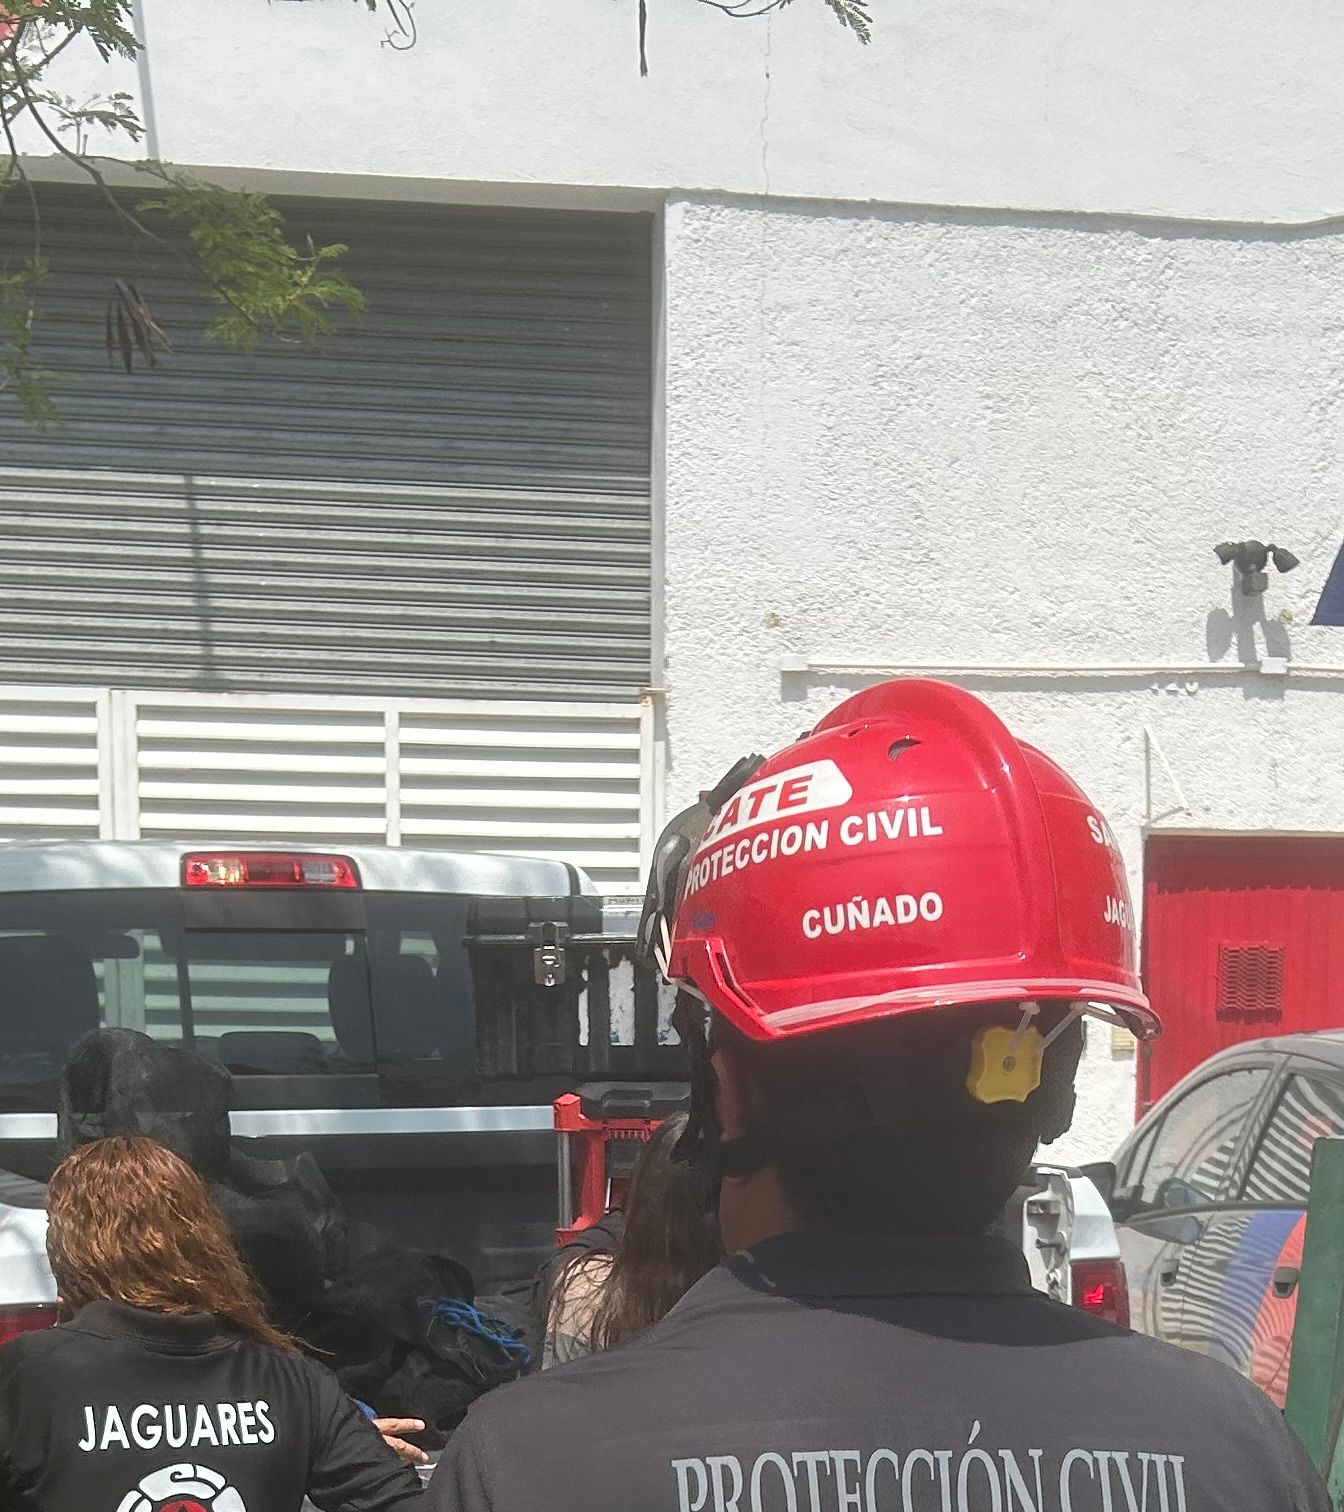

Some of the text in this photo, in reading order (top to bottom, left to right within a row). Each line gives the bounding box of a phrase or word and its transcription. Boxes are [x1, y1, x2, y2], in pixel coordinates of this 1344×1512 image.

[685, 806, 944, 902] PROTECCION CIVIL
[802, 891, 944, 939] CUÑADO
[78, 1400, 276, 1452] JAGUARES
